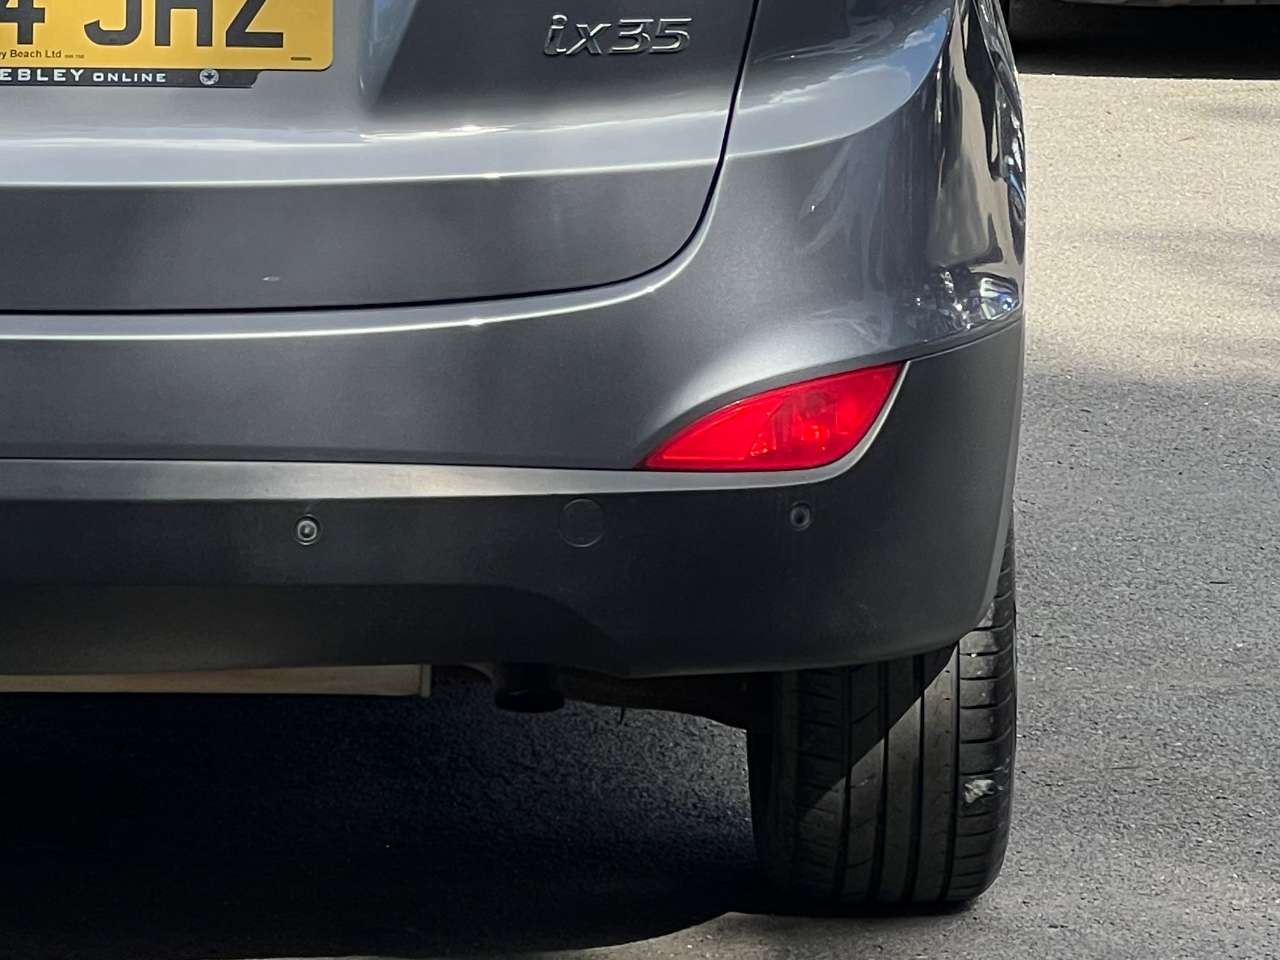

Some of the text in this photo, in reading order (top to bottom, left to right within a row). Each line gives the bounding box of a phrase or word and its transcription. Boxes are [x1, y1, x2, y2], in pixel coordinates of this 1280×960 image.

[544, 14, 693, 56] ix35
[10, 49, 42, 58] Beach
[45, 49, 62, 59] Ltd
[92, 72, 167, 83] ONLINE
